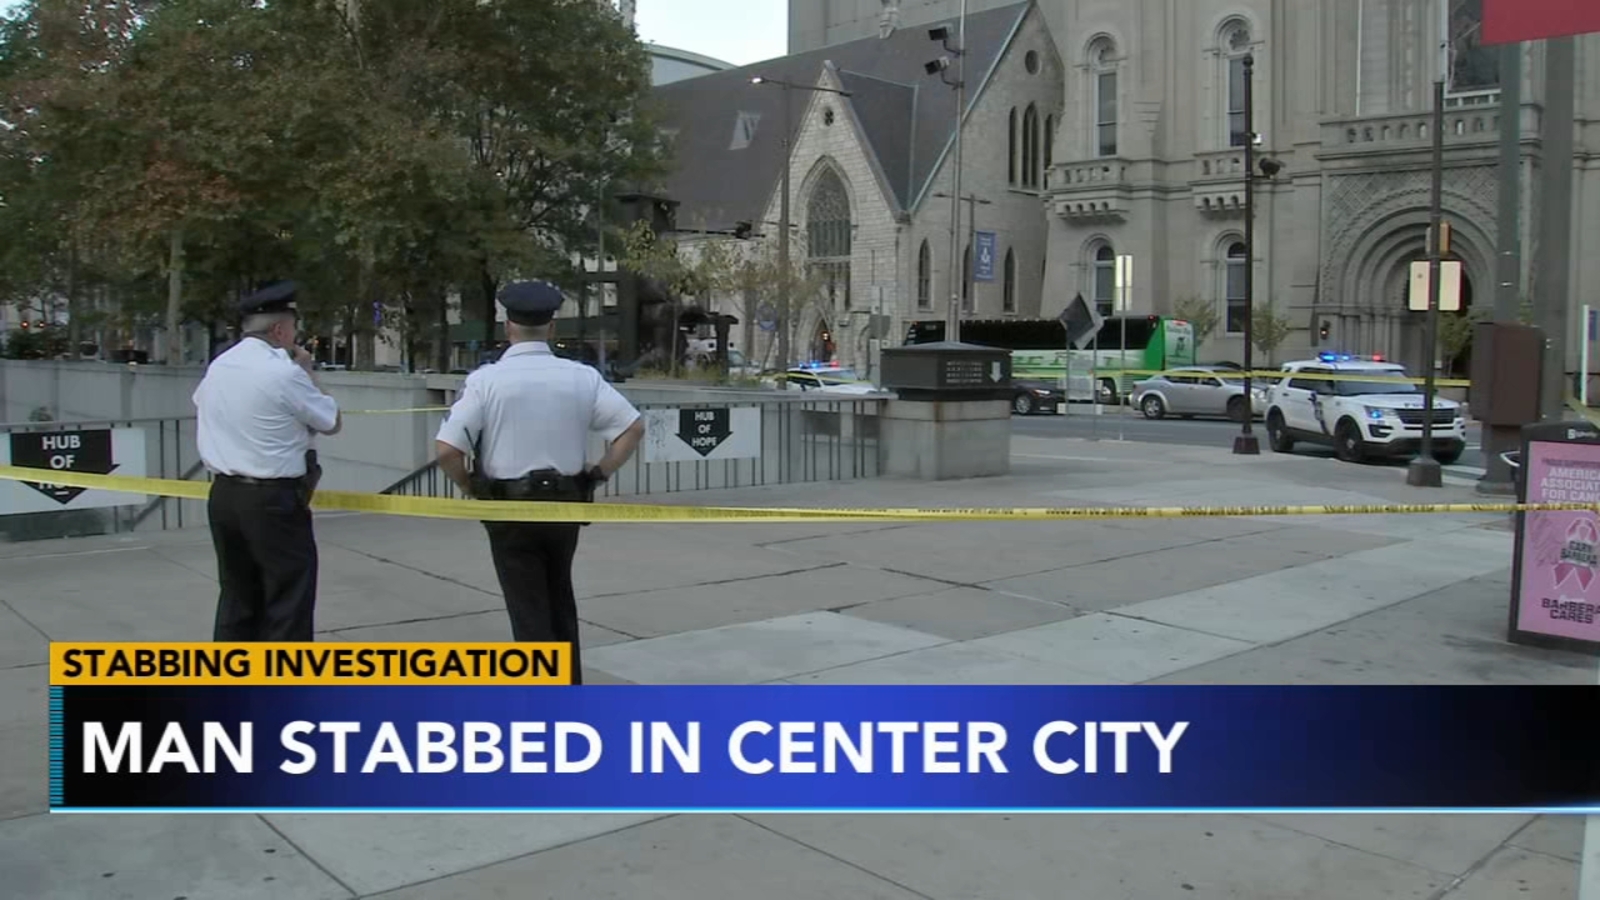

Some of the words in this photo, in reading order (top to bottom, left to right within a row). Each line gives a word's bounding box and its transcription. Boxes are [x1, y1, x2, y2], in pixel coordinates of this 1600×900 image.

[694, 411, 715, 421] HUB
[697, 424, 711, 434] OF
[42, 435, 81, 450] HUB
[692, 436, 717, 447] HOPE
[50, 454, 75, 469] OF
[1549, 467, 1600, 480] AMERIC
[1541, 488, 1566, 500] FOR
[1549, 609, 1594, 624] CARES
